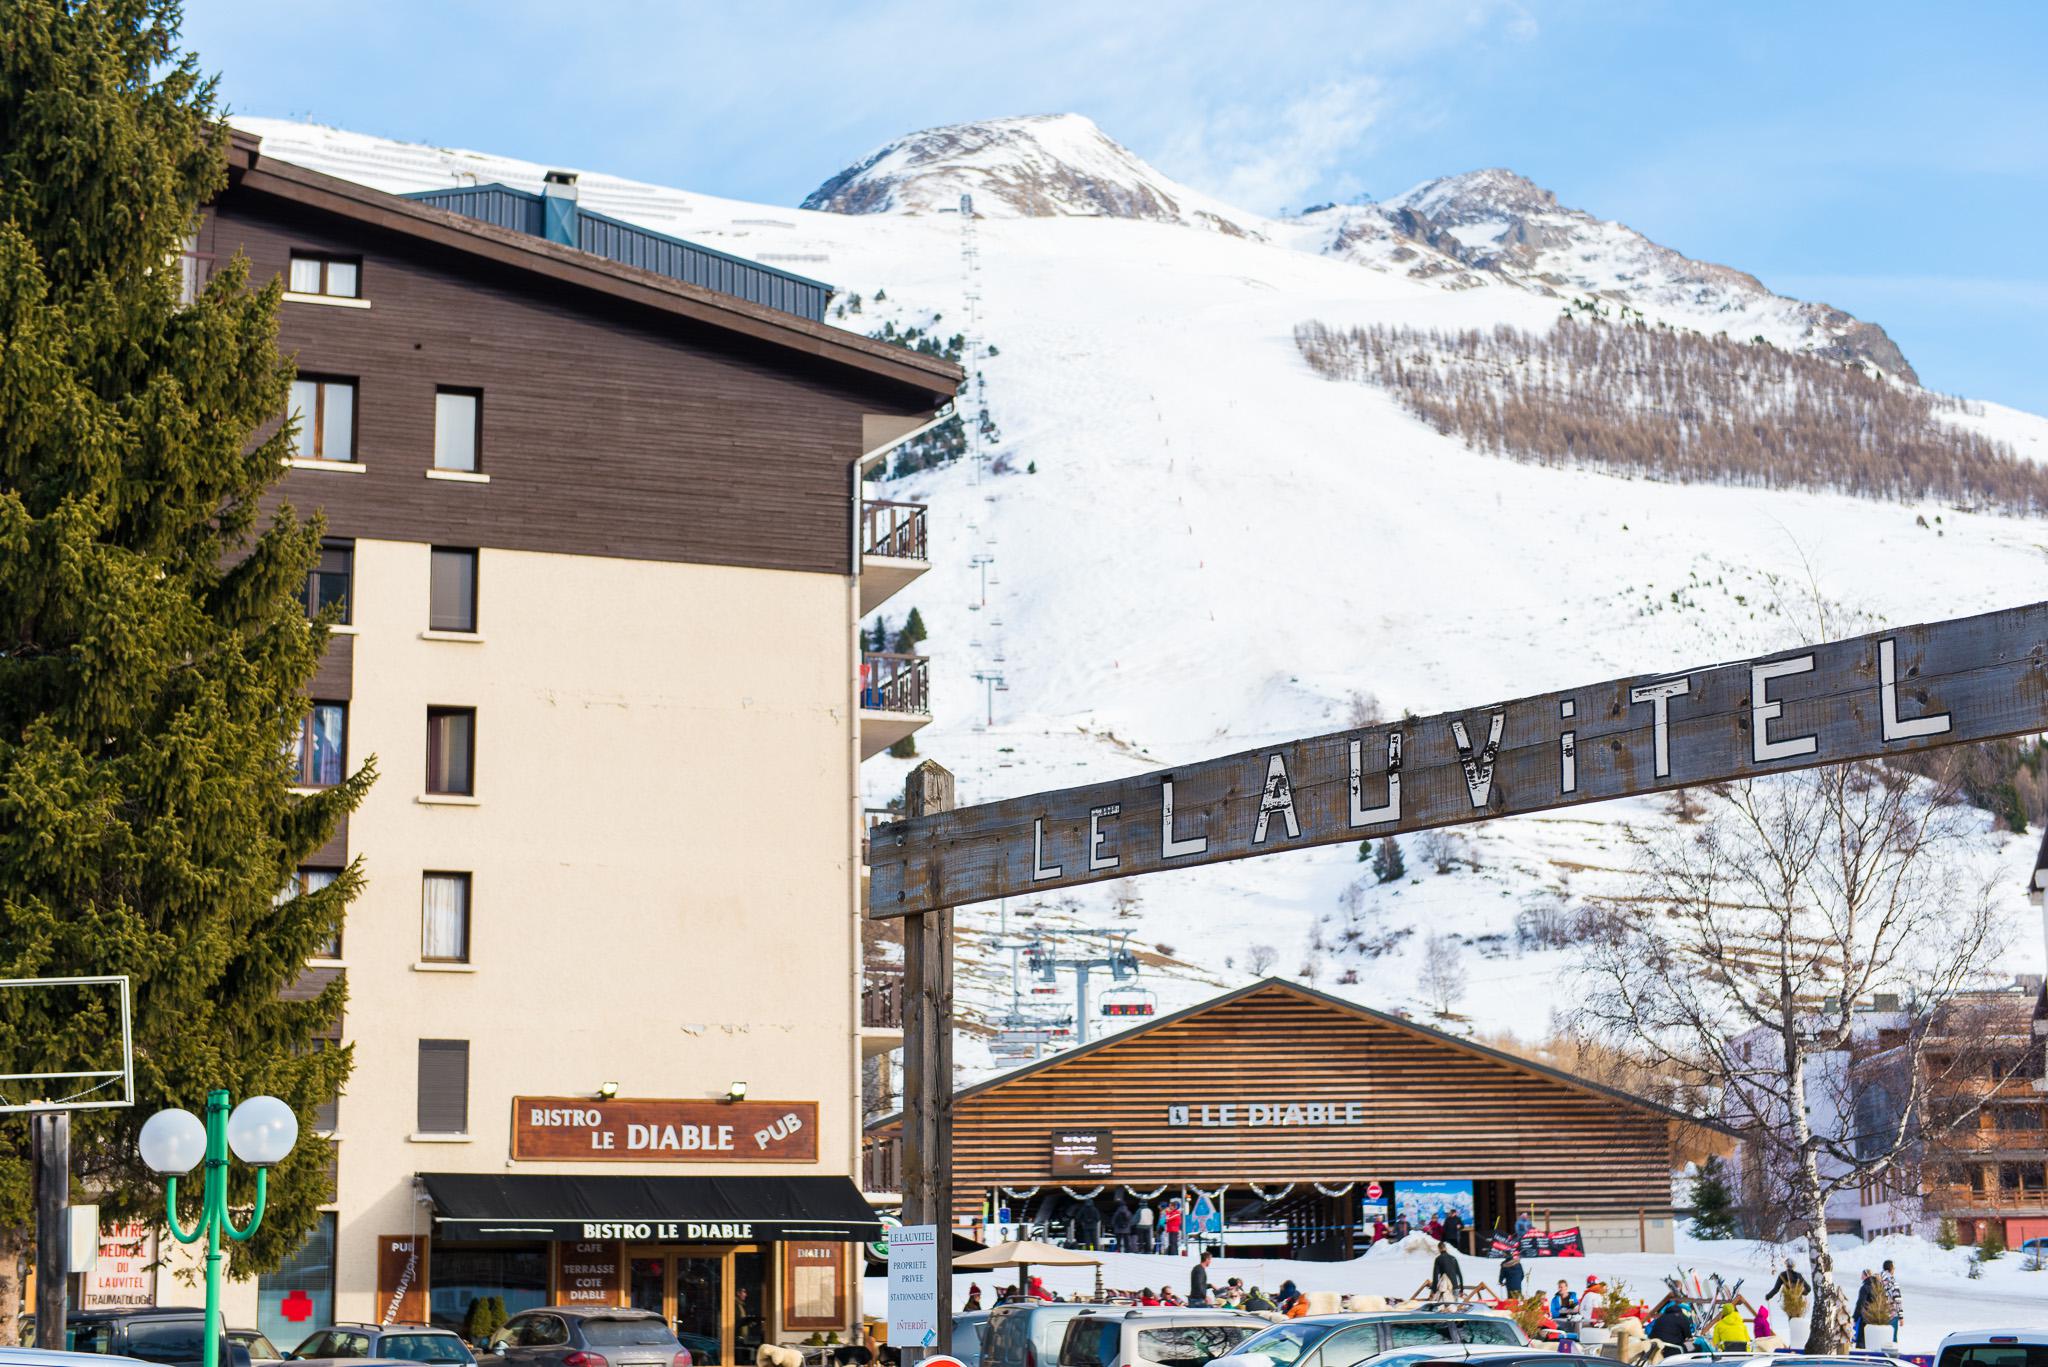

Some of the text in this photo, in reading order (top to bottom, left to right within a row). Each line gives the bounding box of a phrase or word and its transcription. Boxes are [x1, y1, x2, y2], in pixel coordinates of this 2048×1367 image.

[1032, 803, 1121, 882] LE
[531, 1109, 602, 1127] BISTRO
[1201, 1102, 1362, 1127] LE DIABLE
[754, 1112, 803, 1151] PUB
[591, 1124, 735, 1151] LE DIABLE
[583, 1223, 753, 1239] BISTRO LE DIABLE
[890, 1234, 899, 1243] LE
[900, 1232, 934, 1242] LAUVITEL
[576, 1243, 603, 1253] CAFE
[117, 1262, 128, 1273] DU
[564, 1264, 615, 1274] TERRASSE
[893, 1261, 927, 1270] PROPRIETE
[99, 1277, 144, 1288] LAUVITEL
[576, 1278, 603, 1288] COTE
[901, 1274, 924, 1283] PRIVEE
[87, 1294, 153, 1305] TRAUMATOLOGIE
[570, 1290, 606, 1300] DIABLE
[890, 1293, 934, 1302] STATIONNEMENT
[896, 1321, 928, 1330] INTERDIT
